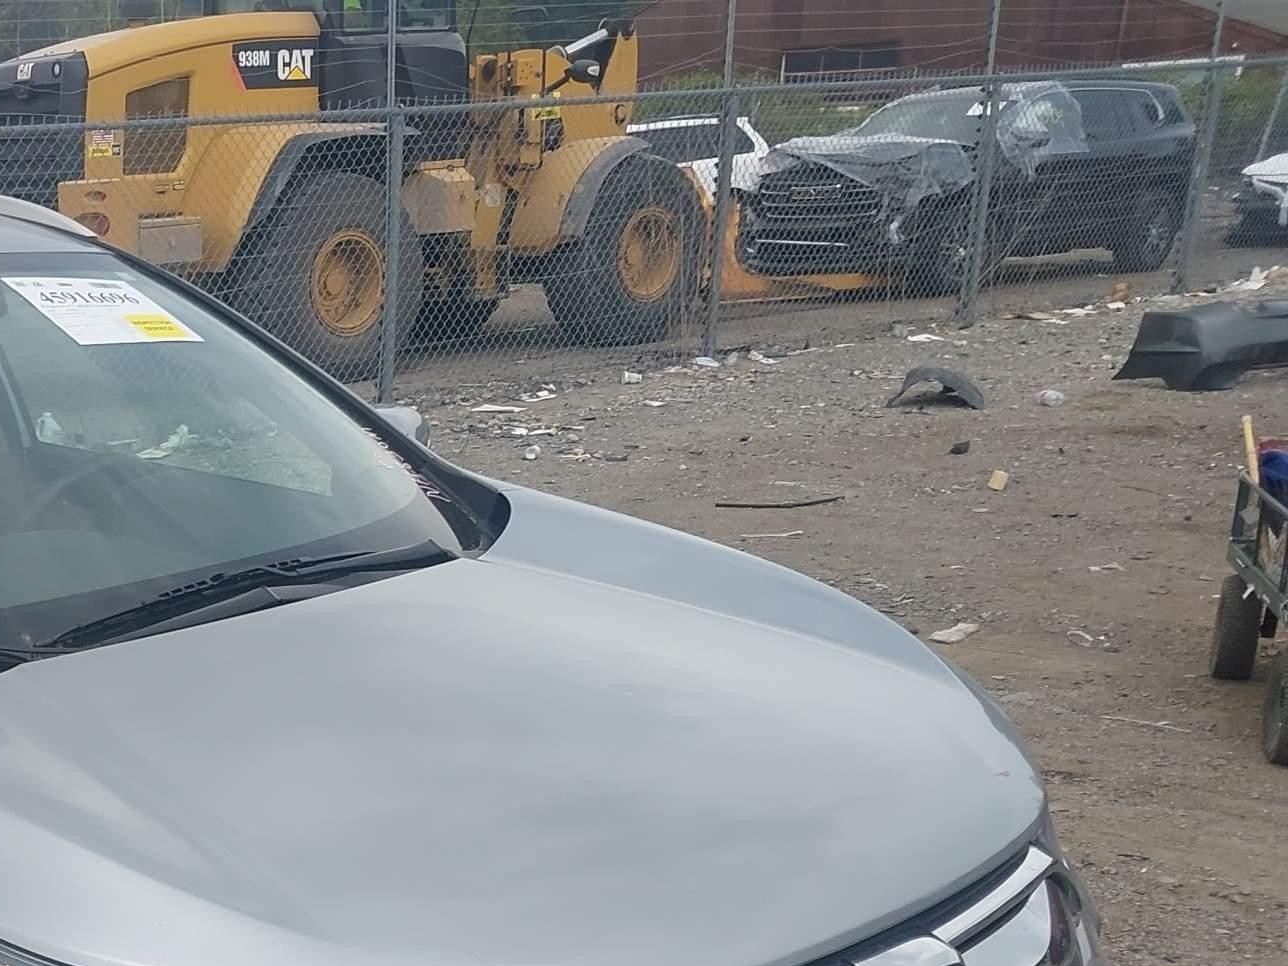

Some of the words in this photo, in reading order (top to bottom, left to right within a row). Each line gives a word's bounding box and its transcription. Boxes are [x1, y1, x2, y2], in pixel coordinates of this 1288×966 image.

[238, 50, 270, 67] 938M
[277, 48, 314, 80] CAT
[38, 290, 140, 305] 45916696
